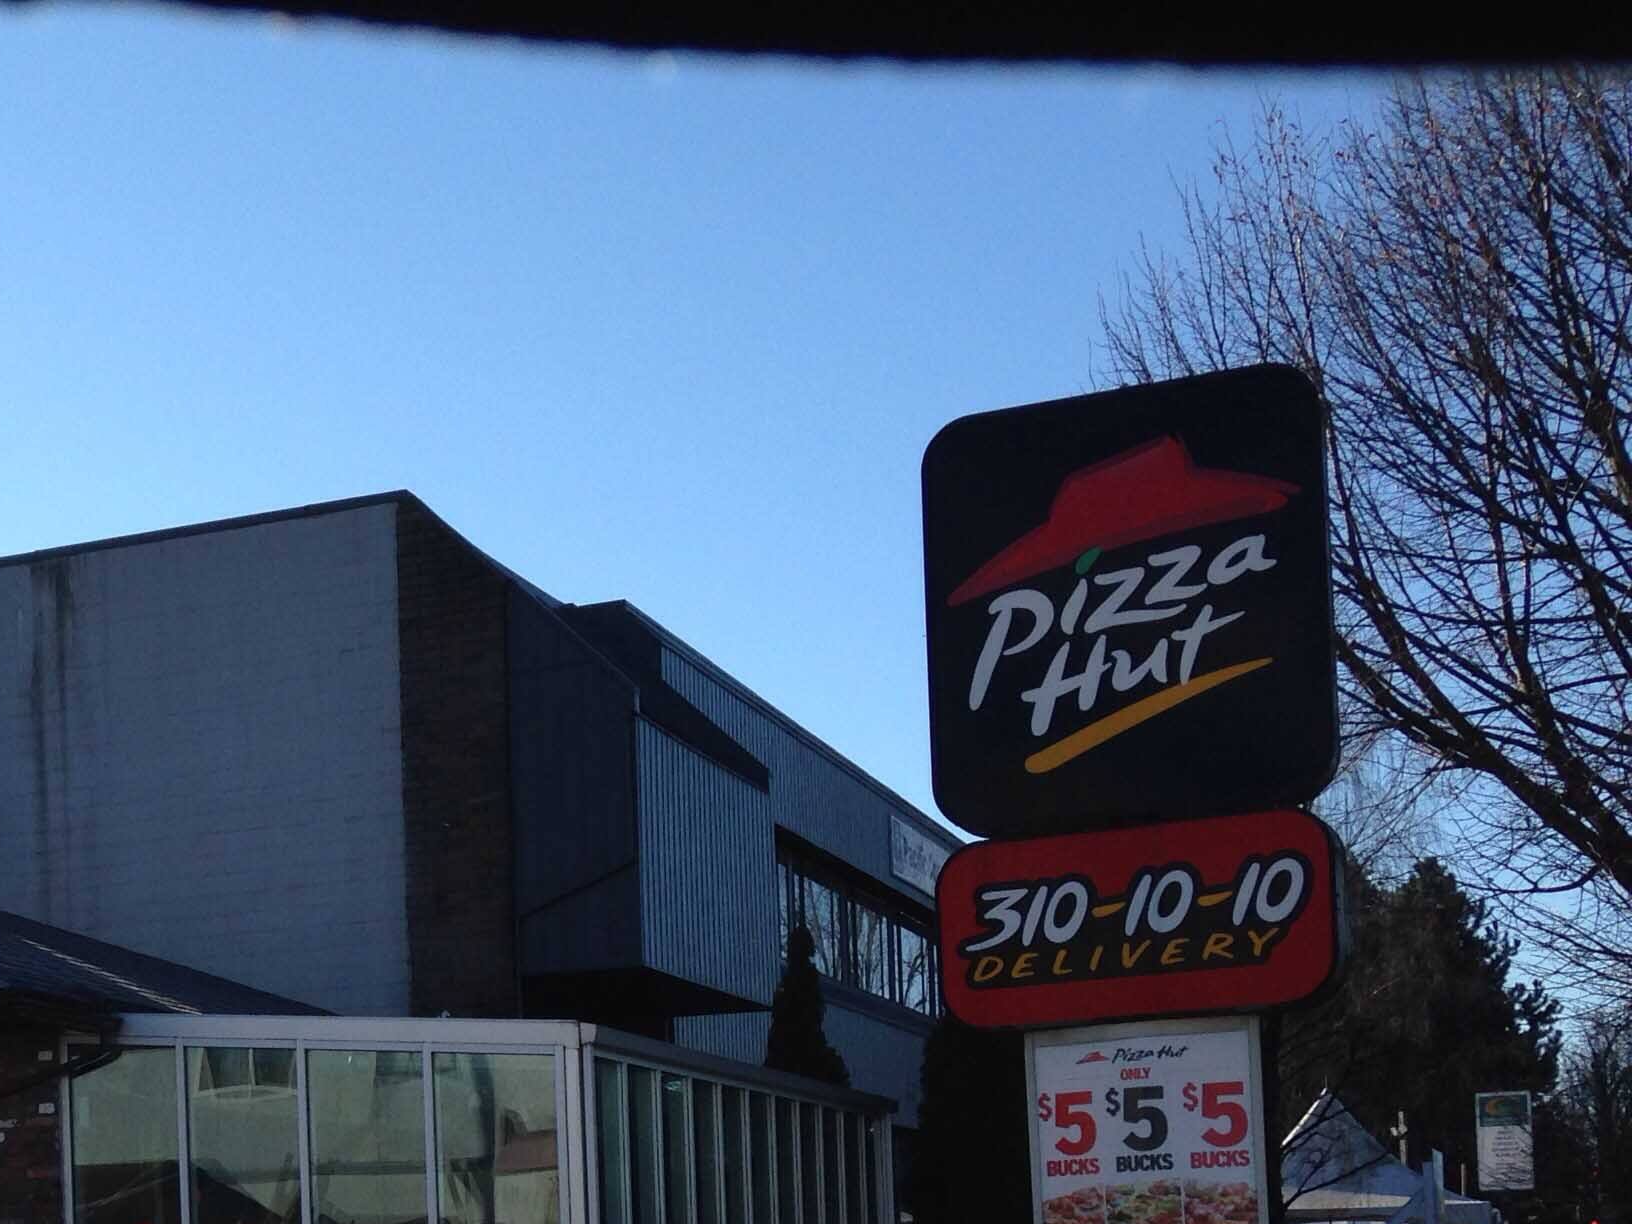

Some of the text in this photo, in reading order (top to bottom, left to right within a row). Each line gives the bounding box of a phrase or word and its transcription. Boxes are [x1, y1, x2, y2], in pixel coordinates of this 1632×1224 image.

[969, 534, 1277, 711] Pizza
[1021, 605, 1245, 736] Hut
[966, 857, 1305, 951] 310-10-10
[973, 927, 1280, 982] DELIVERY
[1111, 1045, 1188, 1064] Pizza Hut
[1120, 1067, 1151, 1081] ONLY
[1037, 1081, 1249, 1156] $5 $5 $5
[1046, 1150, 1250, 1177] BUCKS BUCKS BUCKS
